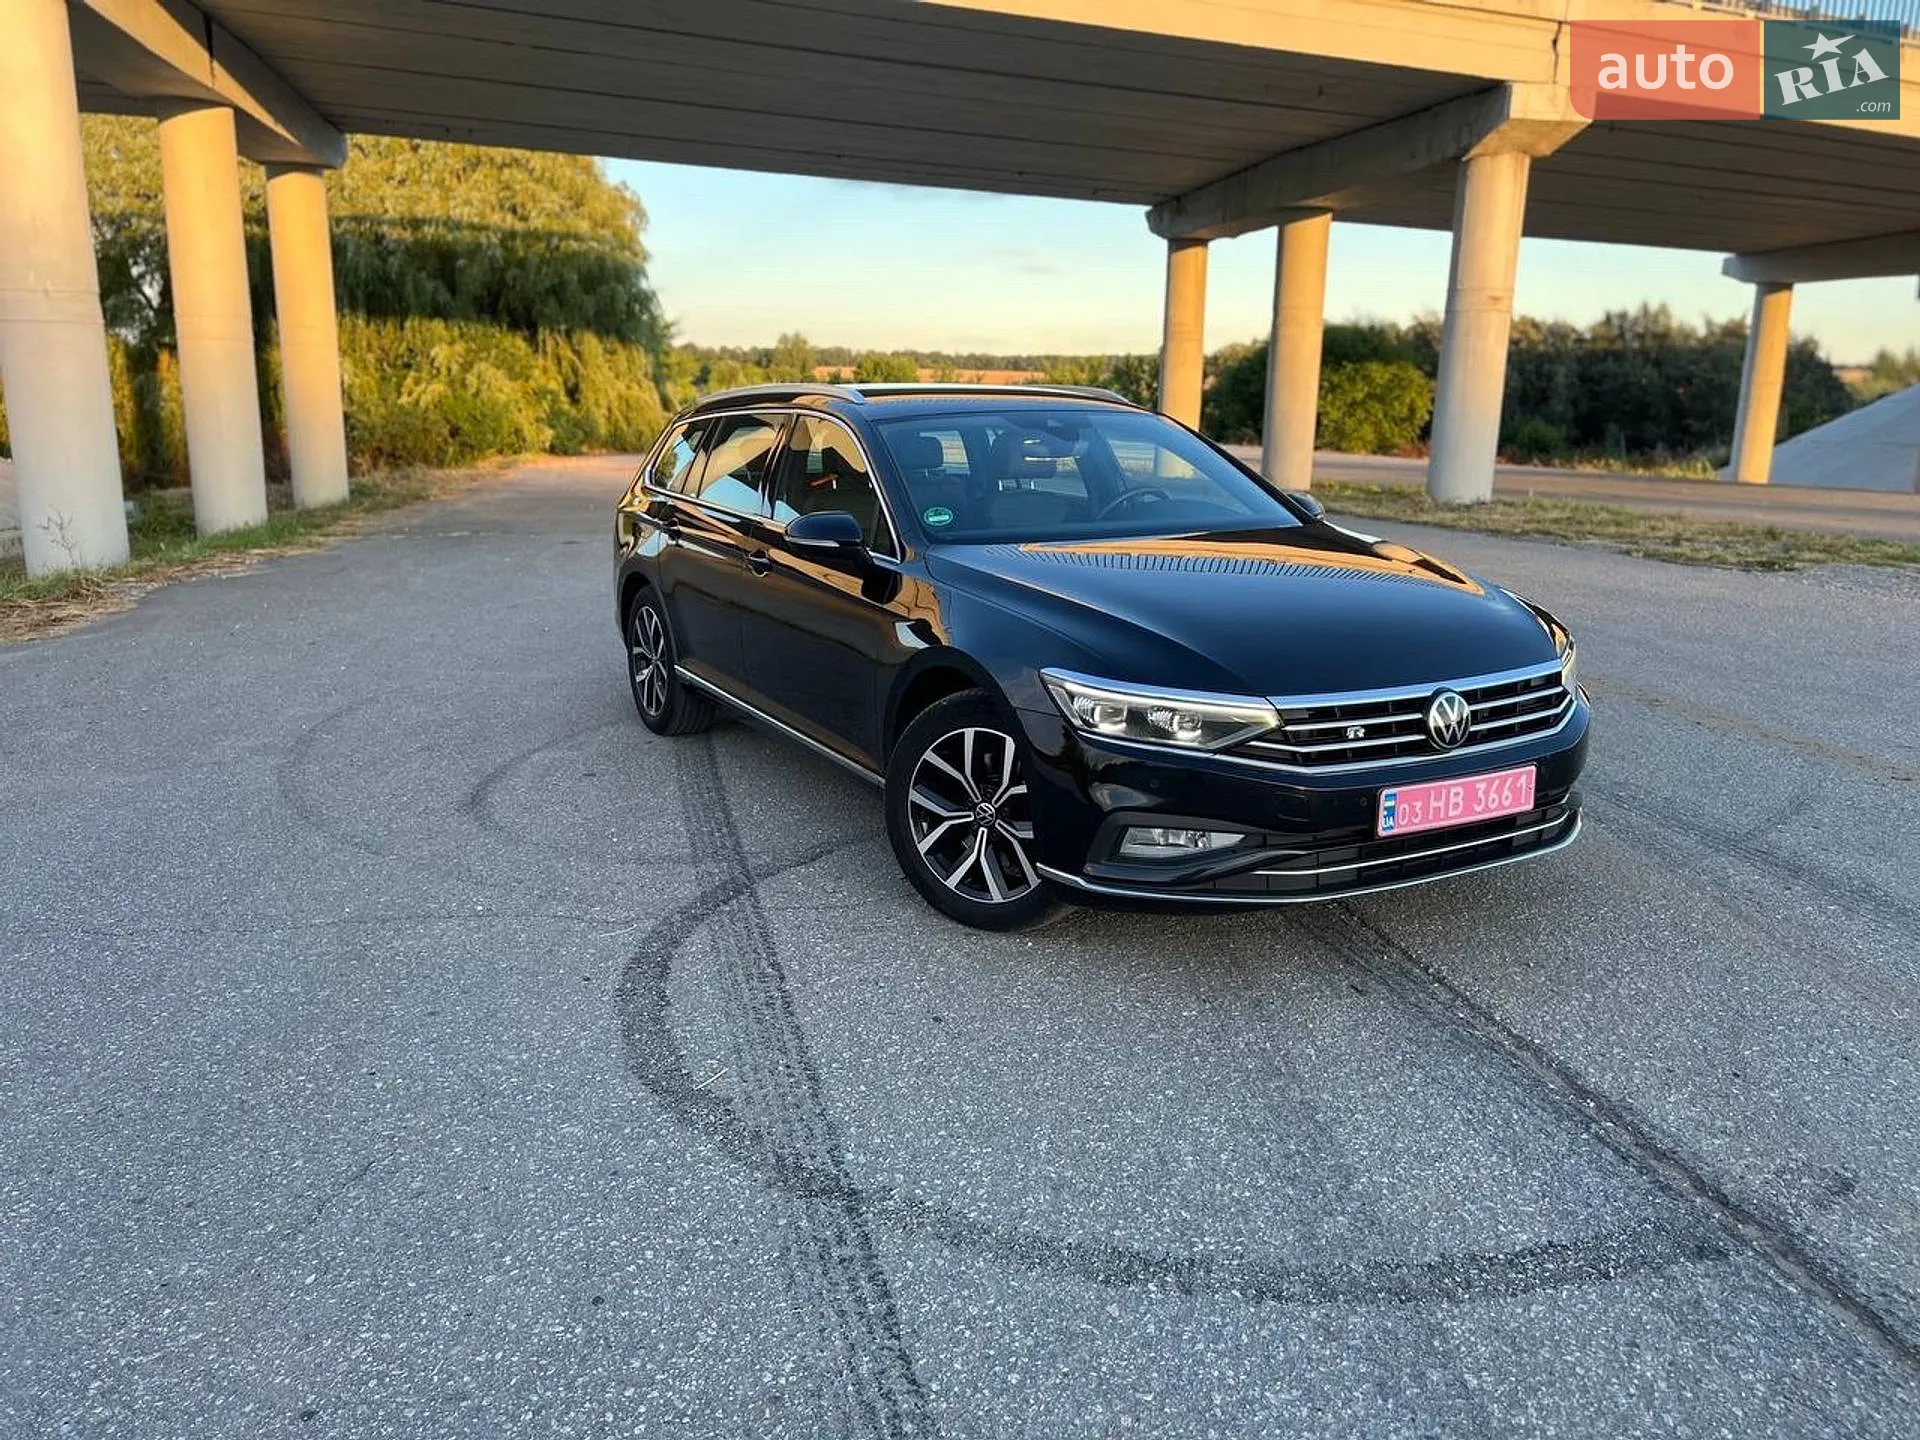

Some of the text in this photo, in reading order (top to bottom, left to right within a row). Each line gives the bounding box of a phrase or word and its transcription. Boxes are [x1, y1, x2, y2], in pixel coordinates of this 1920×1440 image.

[1398, 774, 1528, 826] 03 HB 3661
